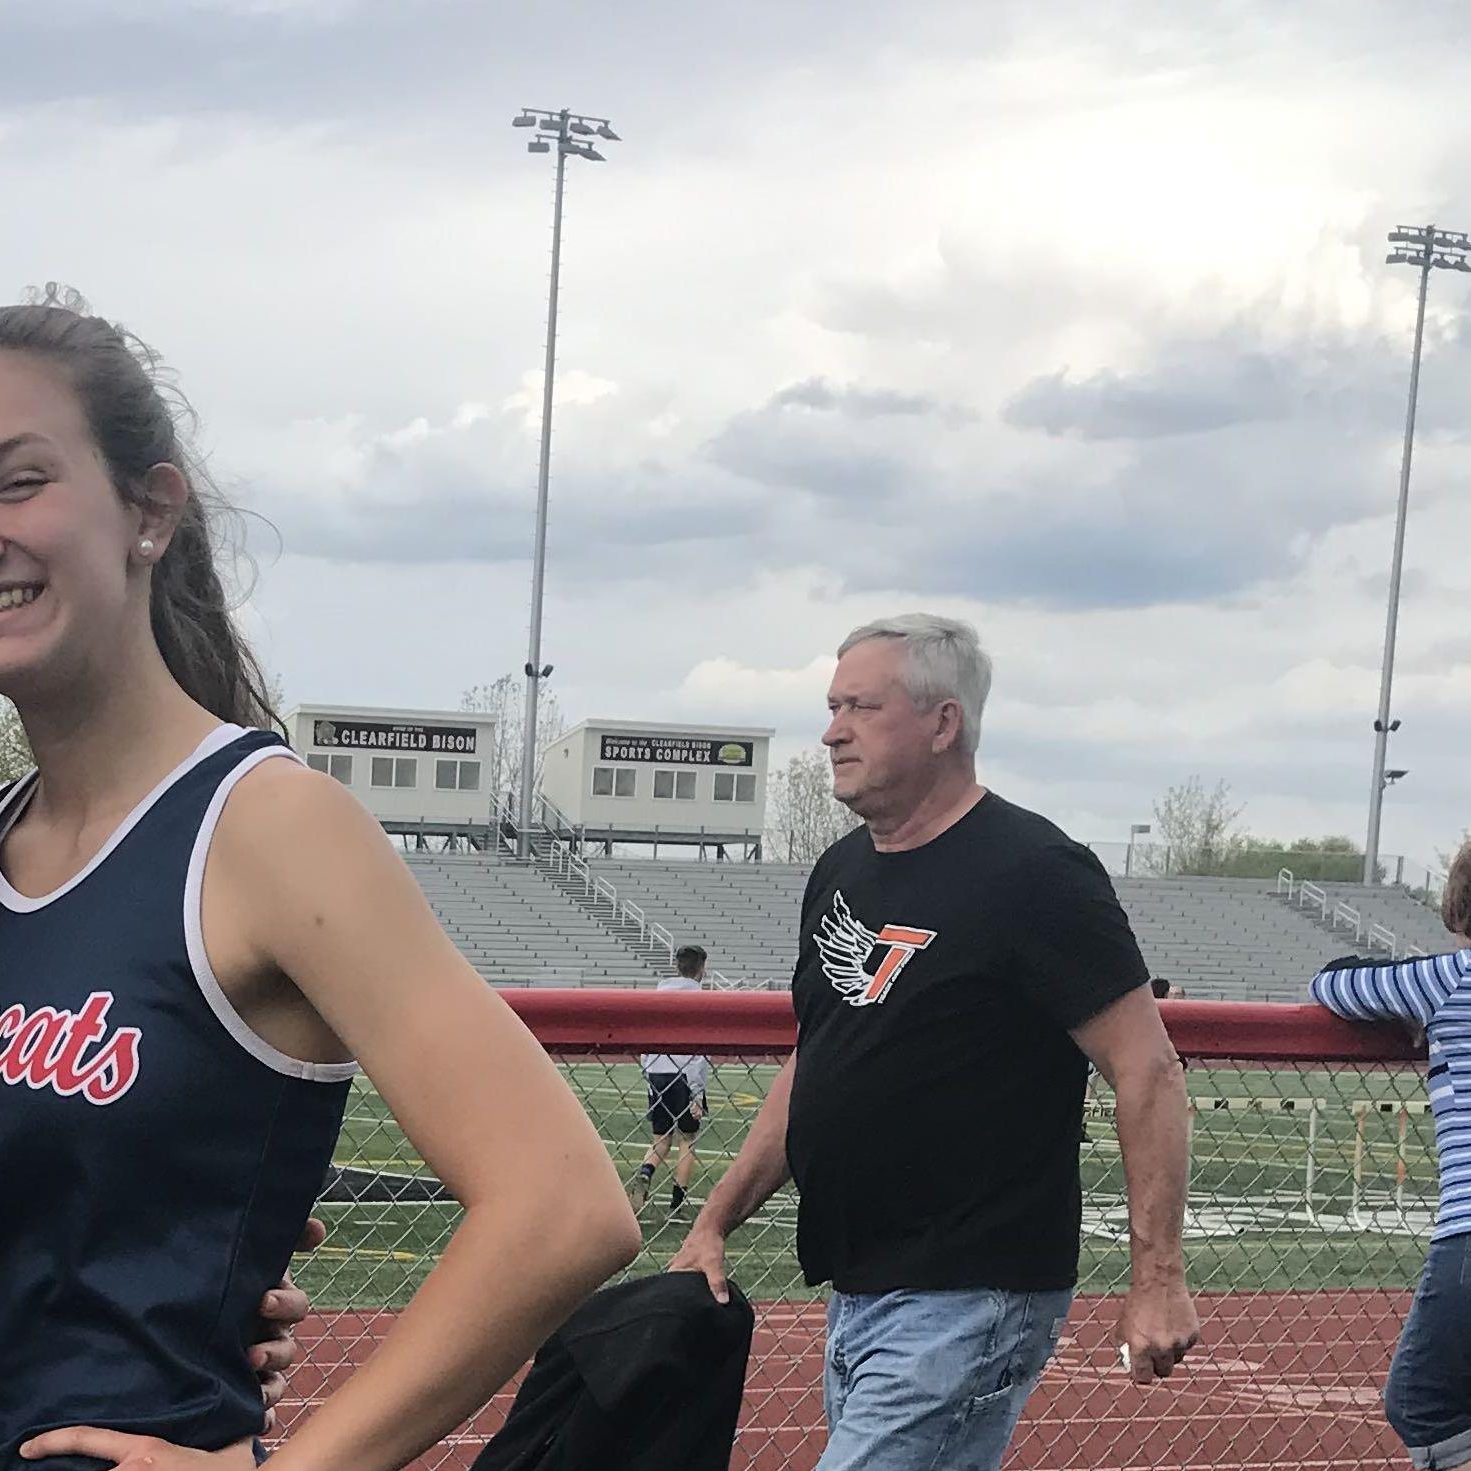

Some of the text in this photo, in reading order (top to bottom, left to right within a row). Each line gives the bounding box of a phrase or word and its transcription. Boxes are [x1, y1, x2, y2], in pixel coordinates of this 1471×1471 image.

[341, 729, 475, 751] CLEARFIELD BISON
[604, 745, 712, 763] SPORTS COMPLEX
